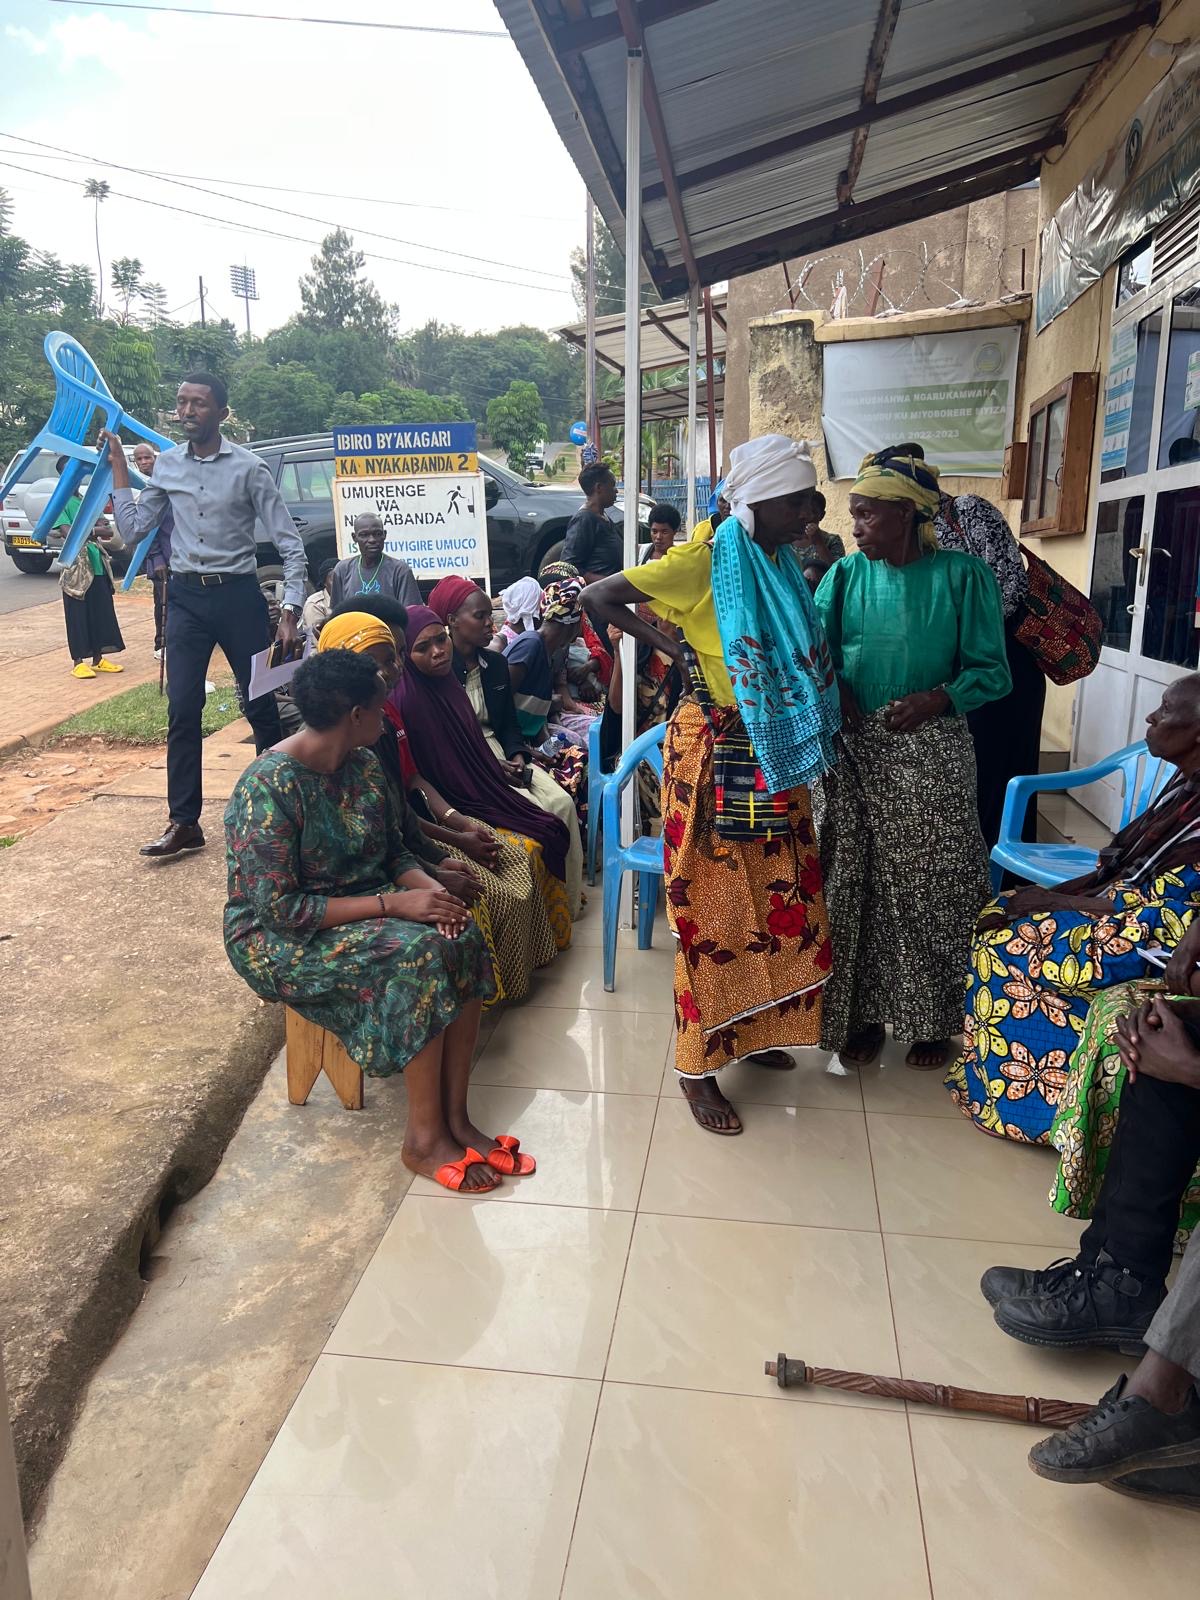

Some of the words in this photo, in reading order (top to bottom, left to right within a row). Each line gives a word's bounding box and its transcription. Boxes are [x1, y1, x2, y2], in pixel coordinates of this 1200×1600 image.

[337, 434, 371, 450] IBIRO
[377, 431, 451, 449] BY'AKAGARI
[340, 459, 358, 475] KA
[366, 456, 453, 474] NYAKABANDA
[457, 453, 469, 471] 2
[342, 484, 426, 499] UMURENGE
[376, 499, 400, 512] WA
[344, 512, 446, 527] NABANDA
[384, 540, 433, 552] TUYIGIRE
[436, 538, 476, 550] UMUCO
[437, 556, 469, 568] WACU
